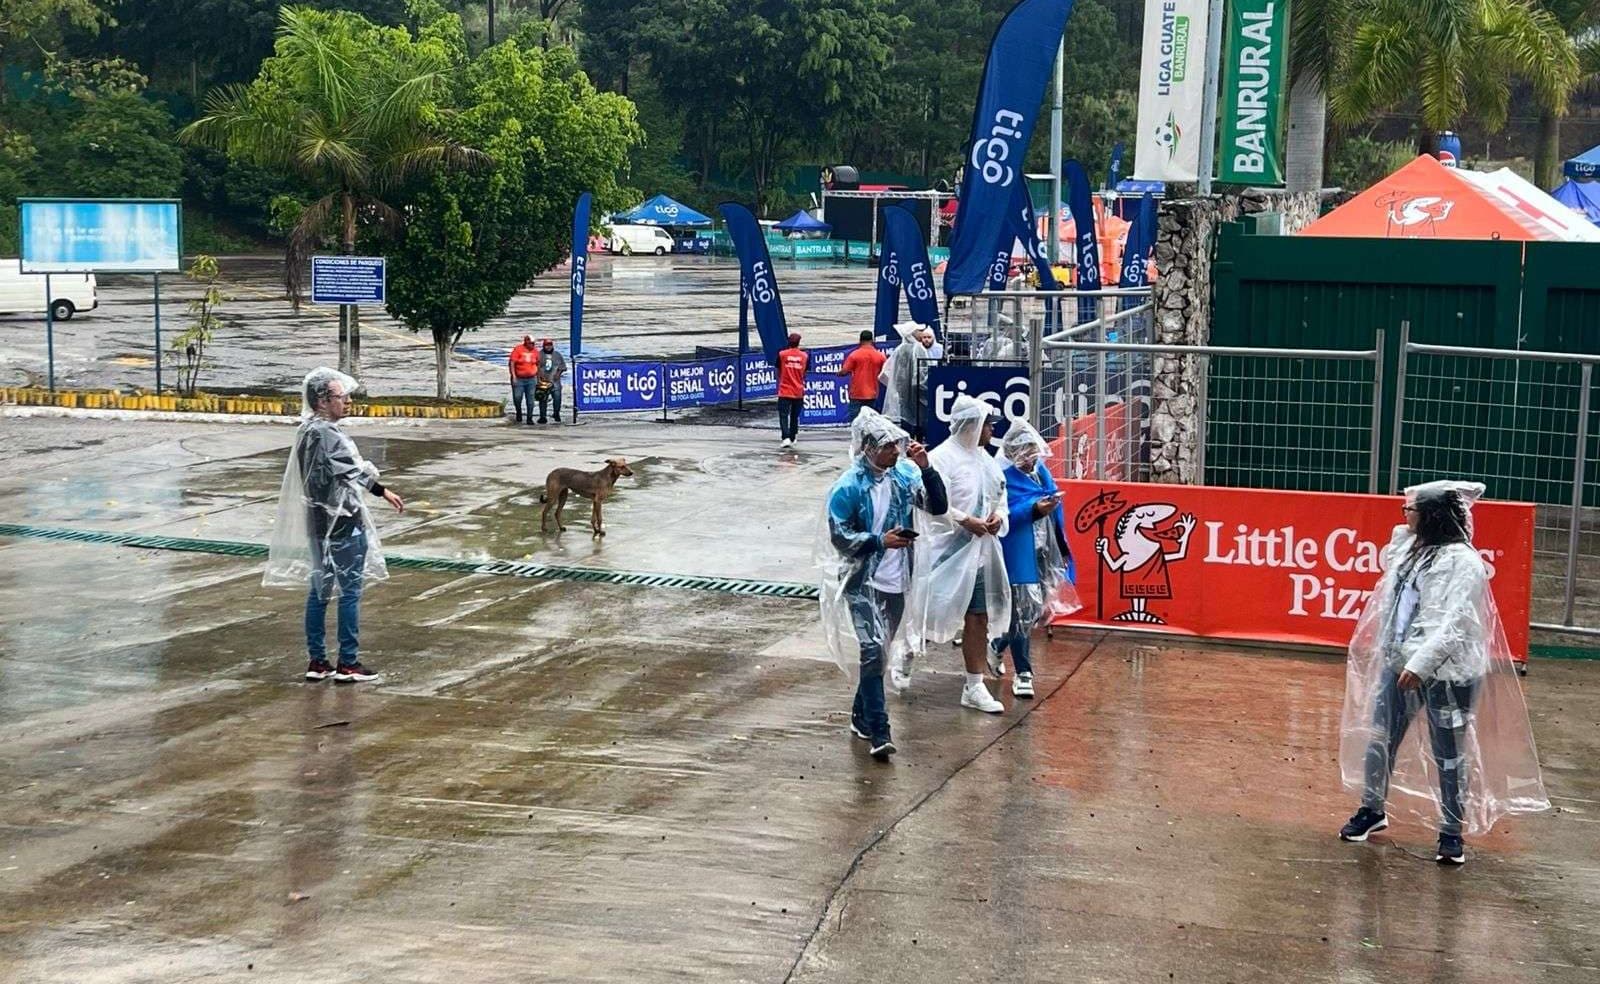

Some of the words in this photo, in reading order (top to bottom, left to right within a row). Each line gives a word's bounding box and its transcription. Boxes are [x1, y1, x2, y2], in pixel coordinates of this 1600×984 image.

[1160, 2, 1176, 56] GUATE
[1173, 21, 1188, 78] BANRURAL
[1158, 60, 1172, 96] LIGA
[1233, 2, 1274, 173] BANRURAL
[983, 109, 1024, 187] tigo
[745, 362, 754, 370] LA
[815, 354, 824, 363] LA
[824, 352, 845, 361] MEJOR
[583, 370, 593, 379] LA
[594, 370, 622, 379] MEJOR
[627, 370, 657, 391] tigo
[670, 369, 680, 378] LA
[680, 367, 704, 376] MEJOR
[708, 365, 735, 386] tigo
[745, 370, 777, 386] SEÑAL
[583, 380, 622, 396] SEÑAL
[670, 378, 704, 394] SEÑAL
[811, 380, 835, 390] MEJOR
[803, 392, 837, 409] SEÑAL
[1203, 521, 1319, 569] Little
